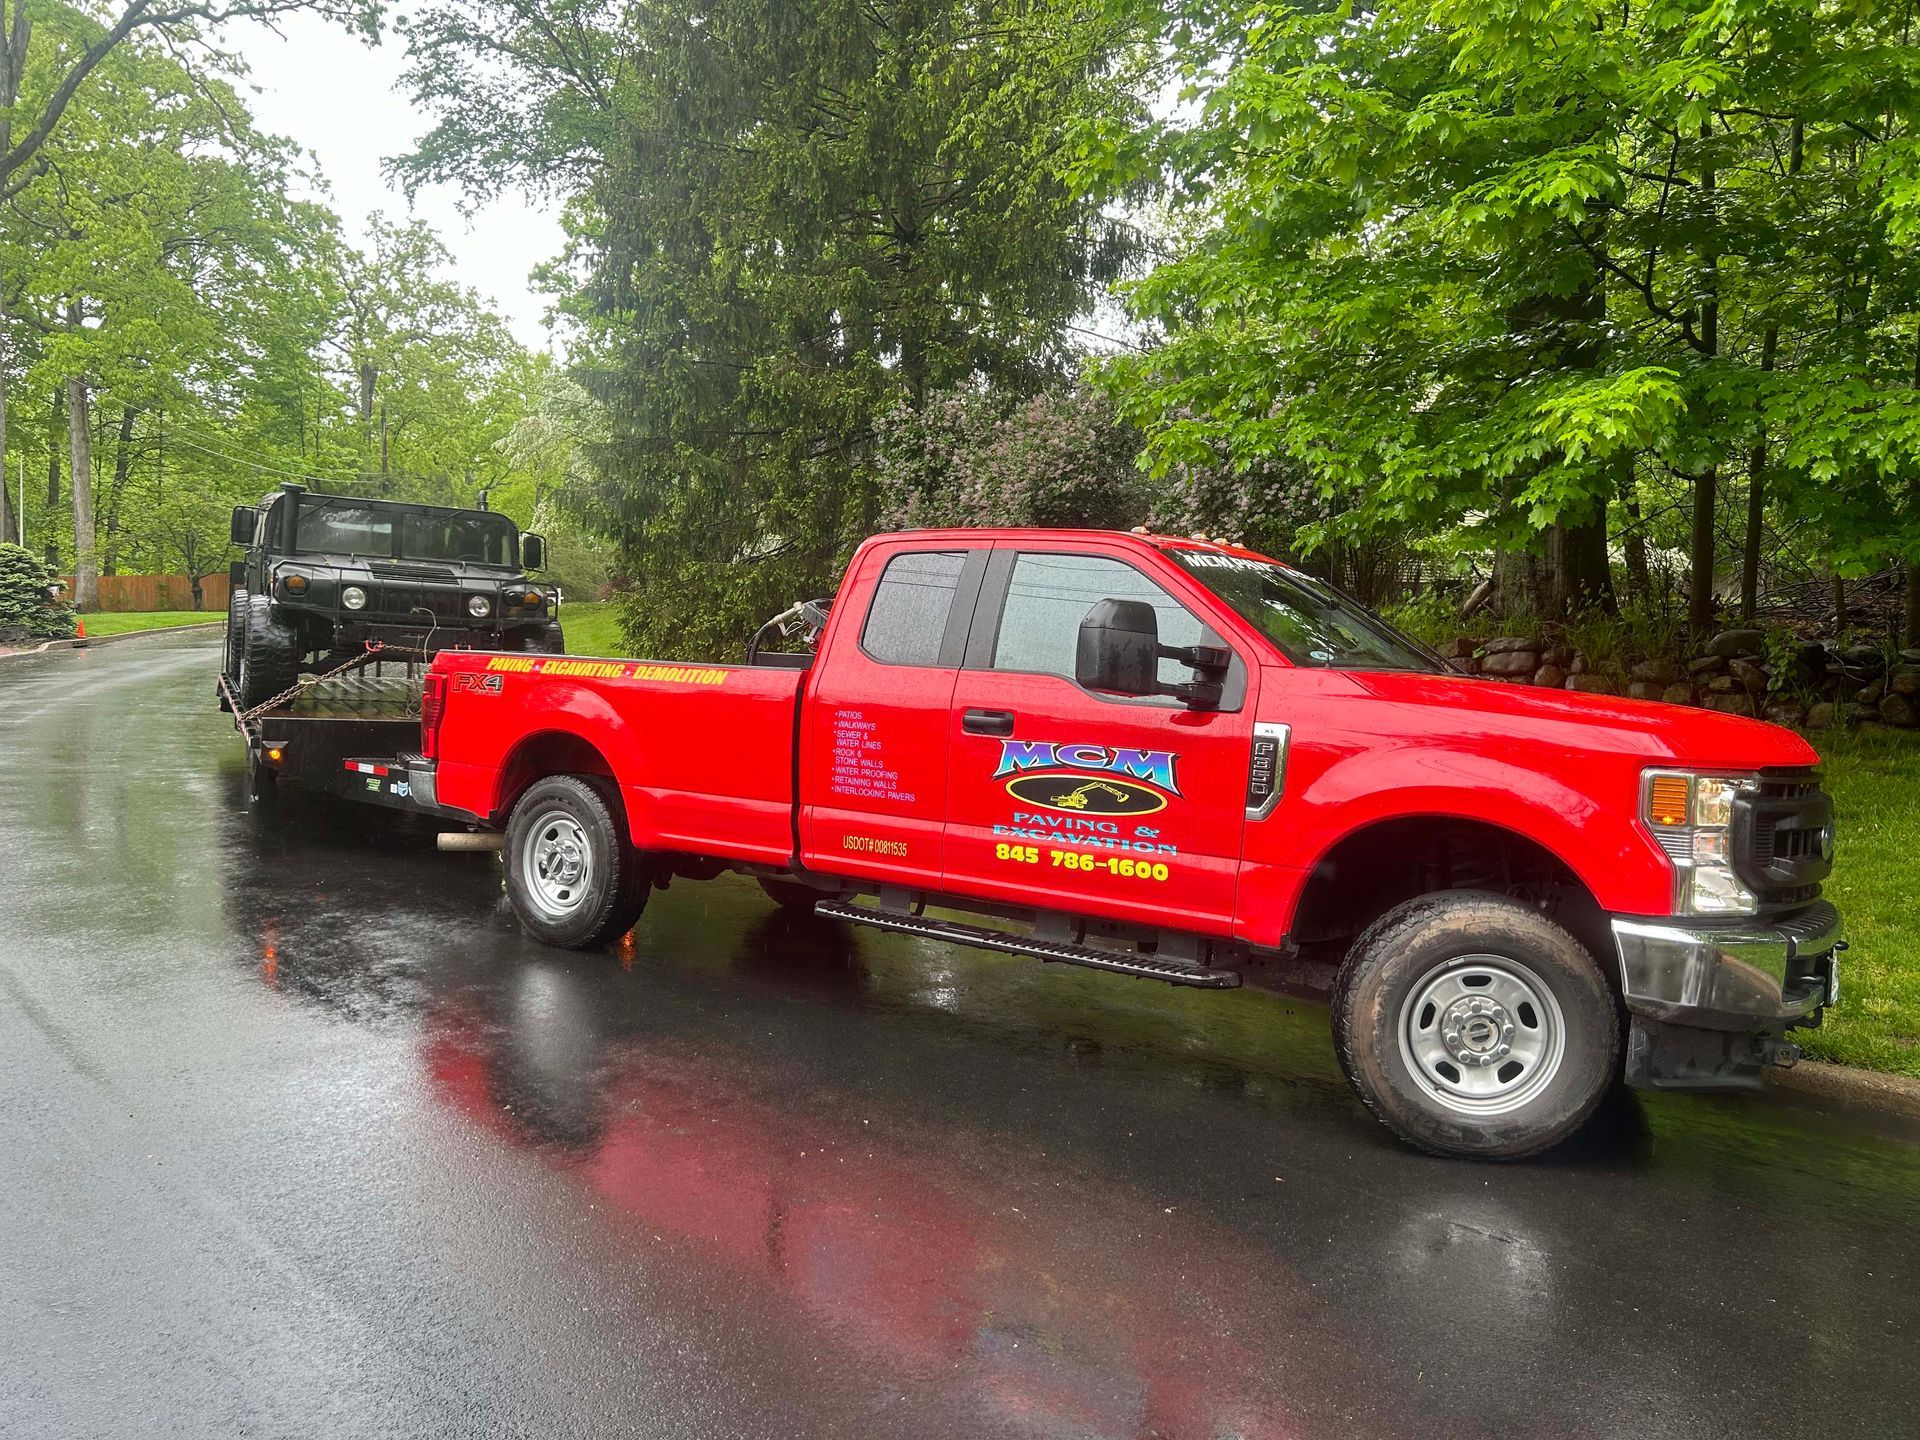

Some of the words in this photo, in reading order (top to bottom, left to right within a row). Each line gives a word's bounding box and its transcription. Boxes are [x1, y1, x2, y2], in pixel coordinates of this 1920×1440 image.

[486, 657, 535, 673] PAVING
[540, 660, 625, 678] EXCAVATING
[632, 665, 728, 685] DEMOLITION
[452, 672, 504, 692] FX4
[838, 710, 862, 720] PATIOS
[838, 721, 876, 731] WALKWAYS
[836, 729, 861, 740] SEWER
[863, 732, 868, 740] &
[836, 739, 860, 748] WATER
[861, 741, 882, 750] LINES
[835, 748, 855, 757] ROCK
[857, 750, 862, 758] &
[835, 757, 859, 766] STONE
[860, 759, 884, 769] WALLS
[991, 738, 1184, 800] MCM
[835, 766, 859, 776] WATER
[861, 768, 898, 780] PROOFING
[834, 775, 871, 787] RETAINING
[873, 780, 897, 790] WALLS
[834, 786, 886, 799] INTERLOCKING
[887, 791, 916, 802] PAVERS
[1013, 812, 1119, 834] PAVING
[1134, 826, 1161, 839] &
[992, 824, 1178, 856] EXCAVATION
[996, 843, 1039, 864] 845
[1051, 850, 1169, 882] 786-1600
